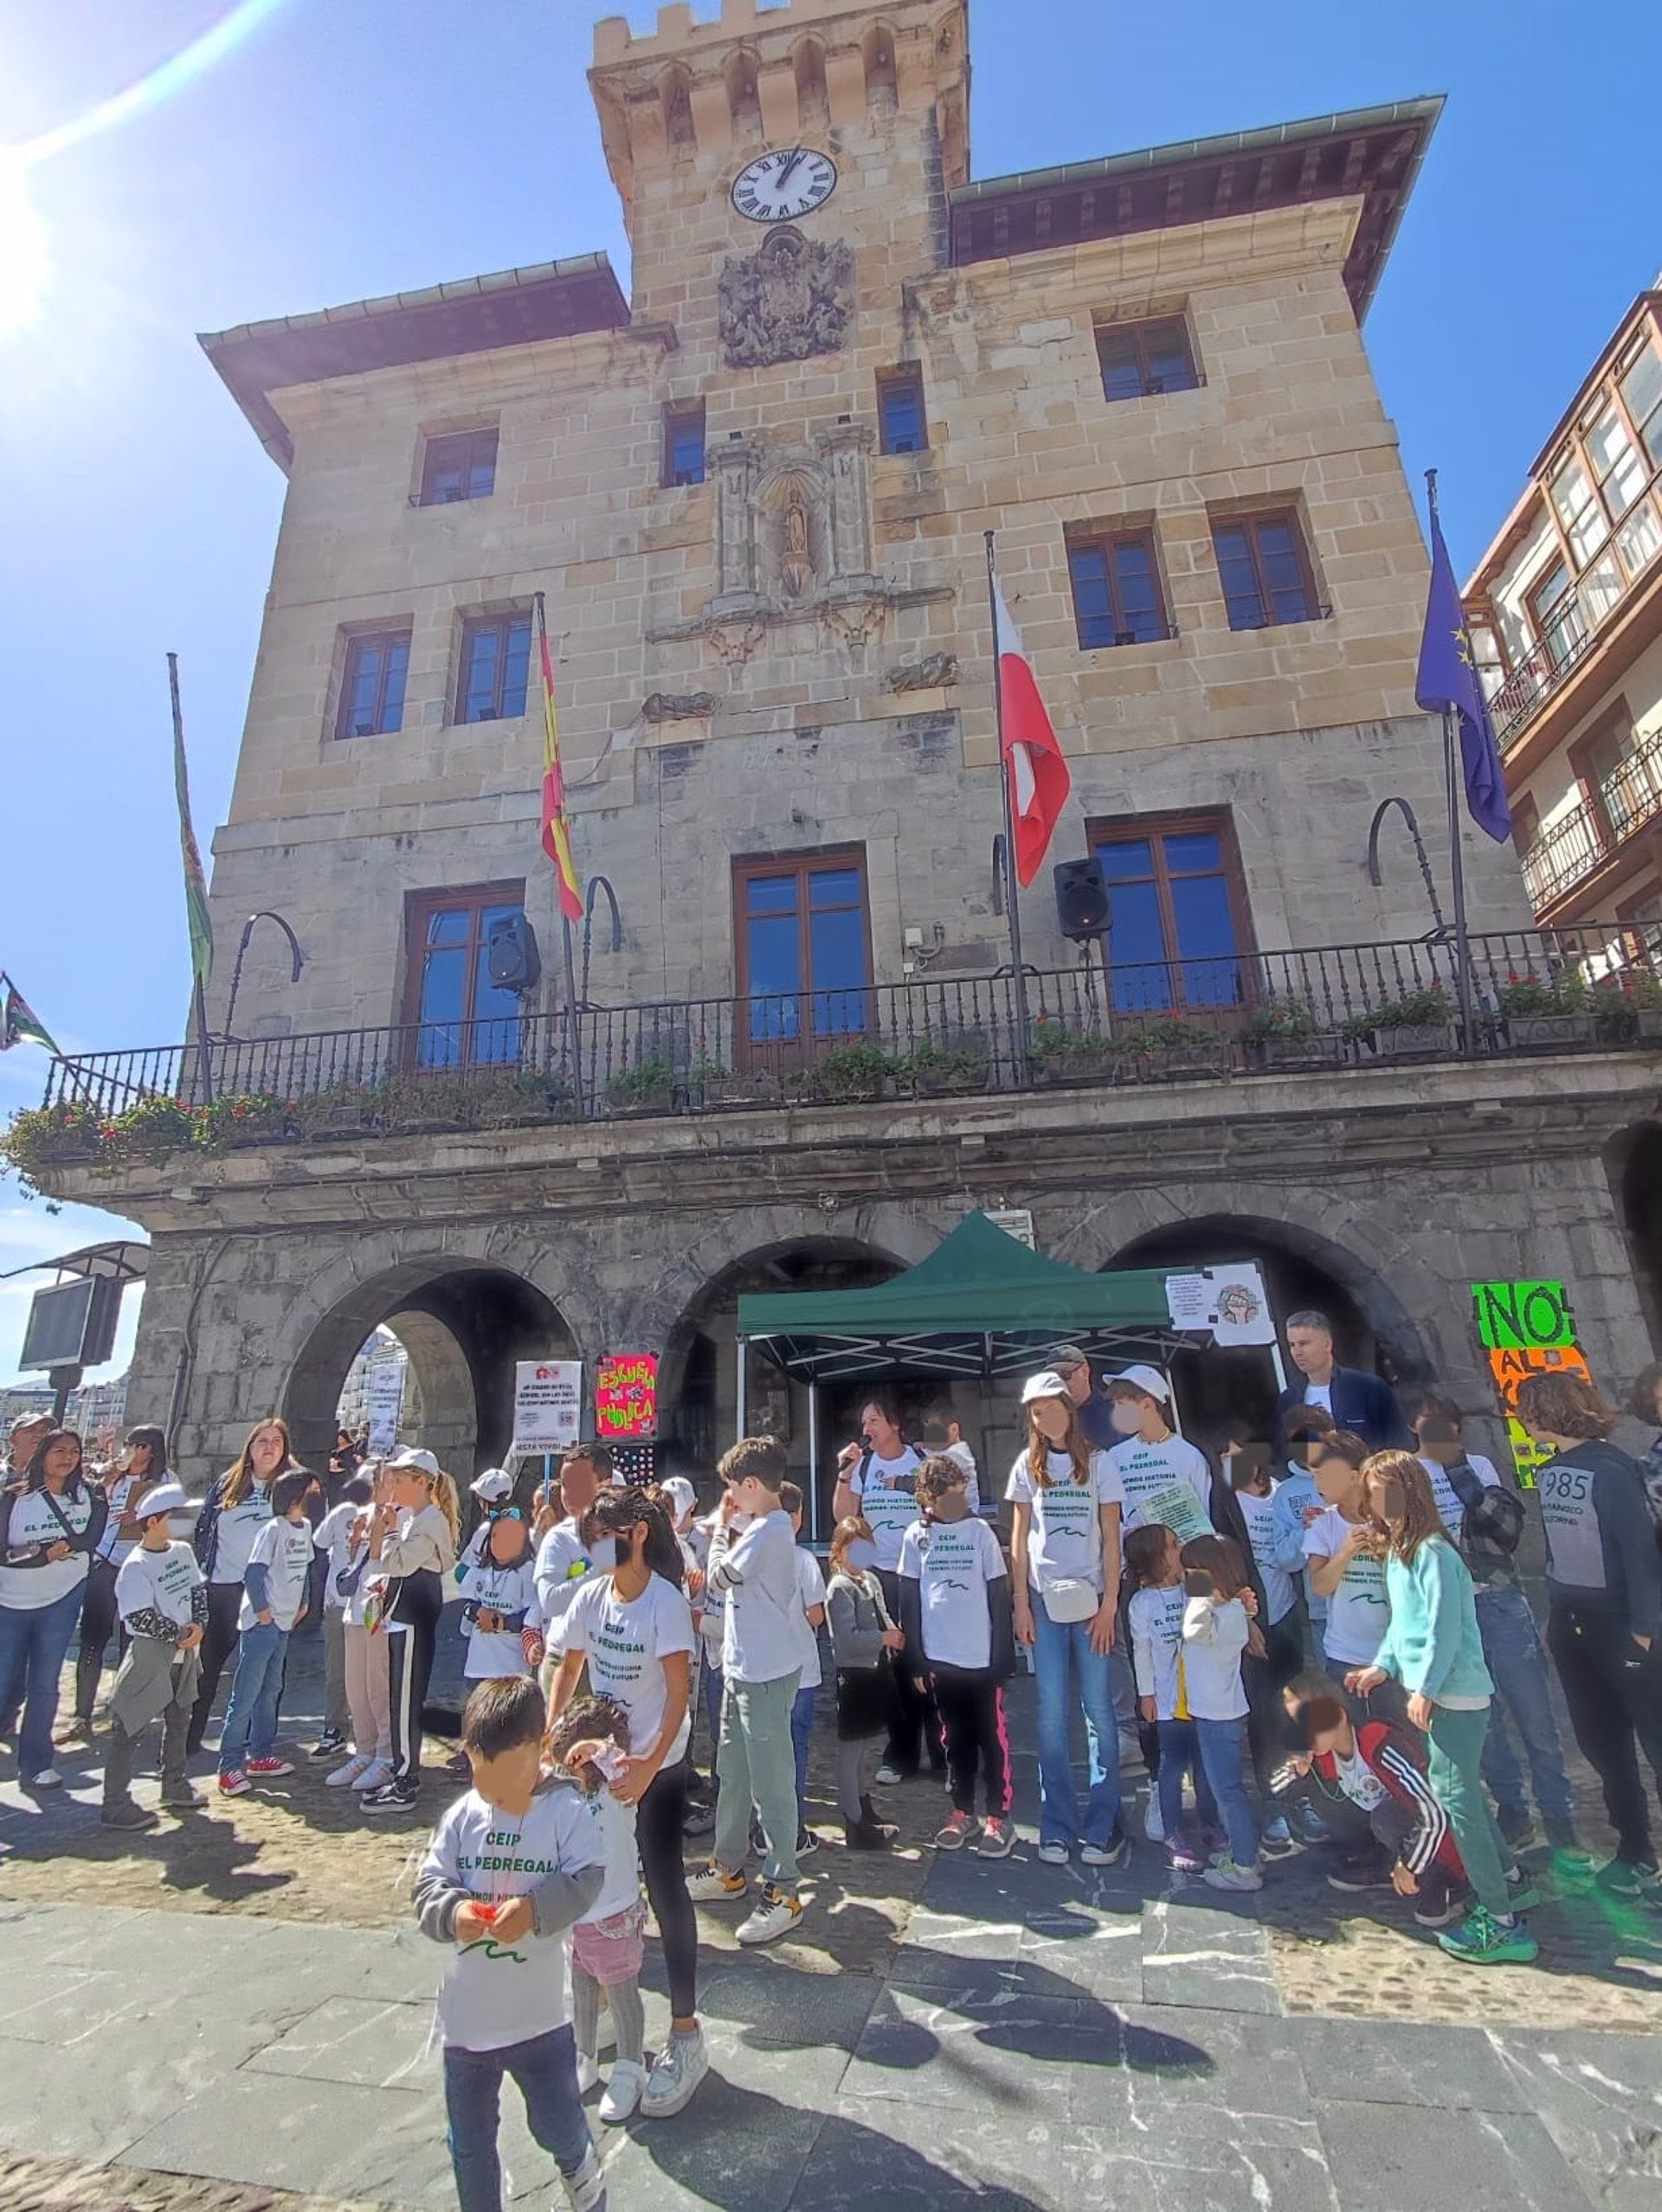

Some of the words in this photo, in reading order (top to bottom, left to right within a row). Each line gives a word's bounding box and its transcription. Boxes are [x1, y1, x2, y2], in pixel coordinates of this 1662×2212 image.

[605, 1622, 625, 1635] CEIP
[598, 1636, 645, 1653] PEDREGAL
[486, 1832, 521, 1847] CEIP
[457, 1856, 473, 1870] EL
[475, 1856, 554, 1874] PEDREGAL
